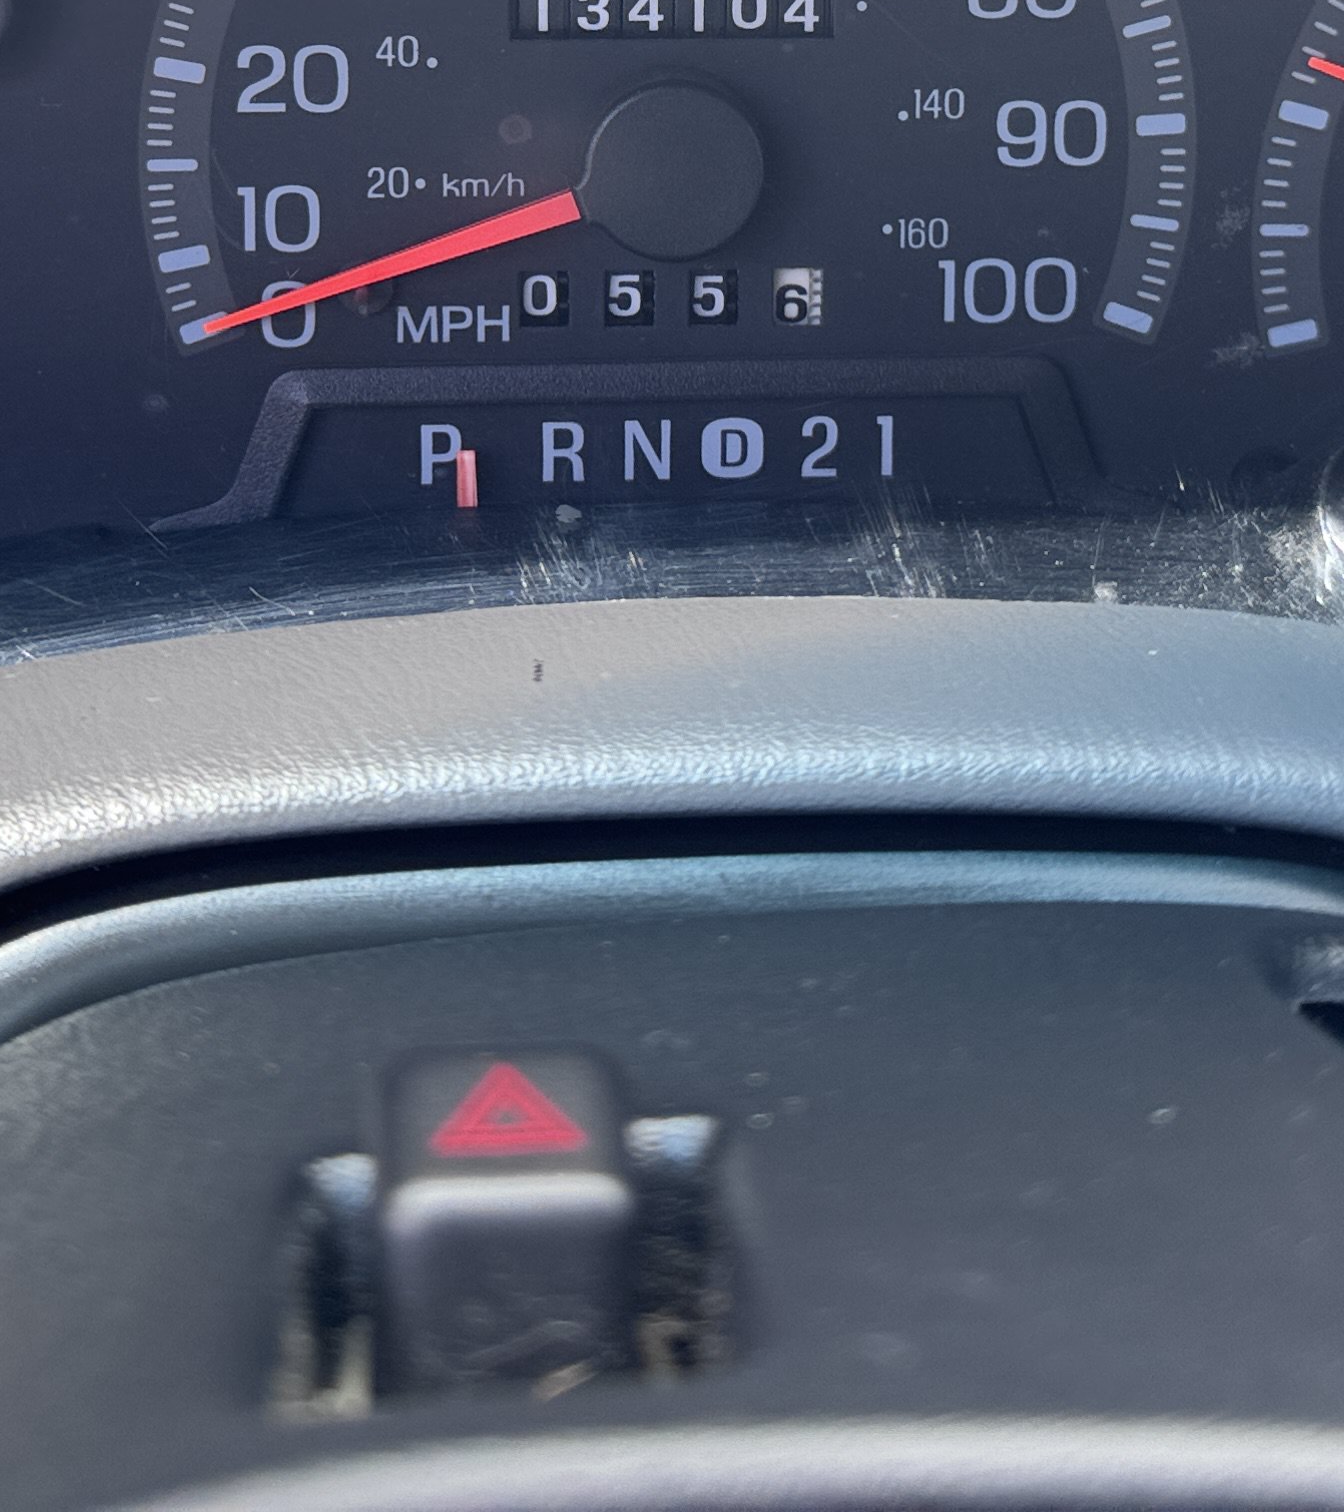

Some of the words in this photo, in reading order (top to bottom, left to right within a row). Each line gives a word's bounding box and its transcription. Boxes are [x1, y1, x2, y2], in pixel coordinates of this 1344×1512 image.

[375, 35, 419, 68] 40
[237, 44, 349, 113] 20
[914, 88, 965, 120] 140
[996, 99, 1107, 168] 90
[367, 166, 409, 199] 20
[442, 172, 525, 197] km/h
[237, 184, 320, 253] 10
[898, 217, 949, 249] 160
[259, 279, 317, 349] 0
[938, 257, 1077, 324] 100
[397, 305, 510, 343] MPH
[420, 423, 462, 486] P
[542, 421, 585, 482] R
[624, 419, 672, 481] N
[801, 415, 838, 478] 2
[876, 415, 894, 476] 1
